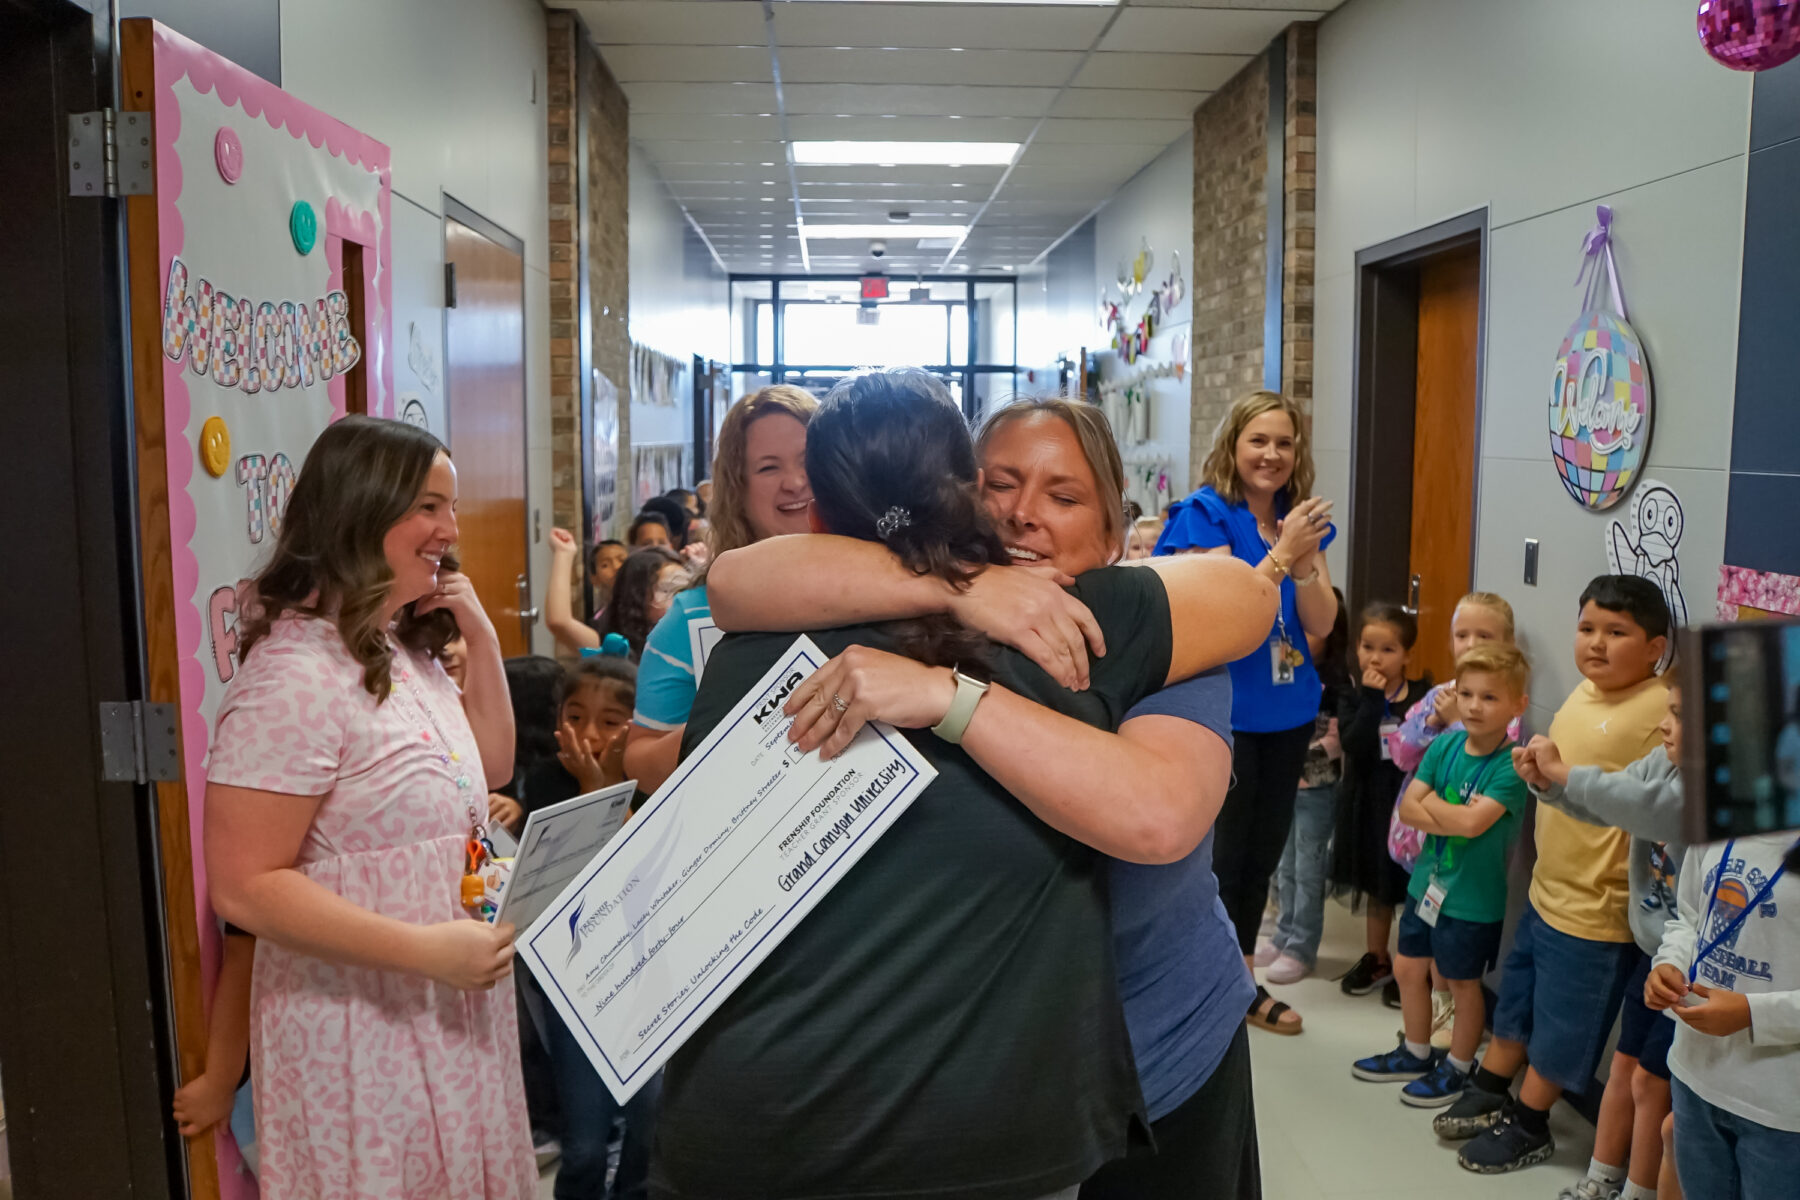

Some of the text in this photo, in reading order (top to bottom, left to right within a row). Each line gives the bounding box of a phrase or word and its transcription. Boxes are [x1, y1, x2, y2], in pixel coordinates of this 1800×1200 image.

[164, 257, 361, 393] WELCOME
[1549, 347, 1642, 455] Welcome
[236, 451, 297, 544] TO
[752, 669, 804, 725] KWA
[777, 814, 812, 851] FRENSHIP
[809, 767, 856, 817] FOUNDATION
[778, 850, 817, 892] Grand
[812, 811, 855, 855] Canyon
[779, 828, 810, 861] TEACHER
[808, 803, 833, 830] GRANT
[831, 771, 864, 805] SPONSOR
[581, 874, 641, 939] FOUNDATION
[583, 962, 599, 981] Amy
[680, 852, 703, 879] Ginger
[781, 758, 790, 768] $
[594, 989, 614, 1011] Nine
[614, 954, 647, 991] hundred
[646, 914, 686, 957] forty-four
[636, 1012, 662, 1040] Secret
[688, 941, 730, 986] Unlocking
[727, 927, 743, 944] the
[742, 906, 763, 929] Code
